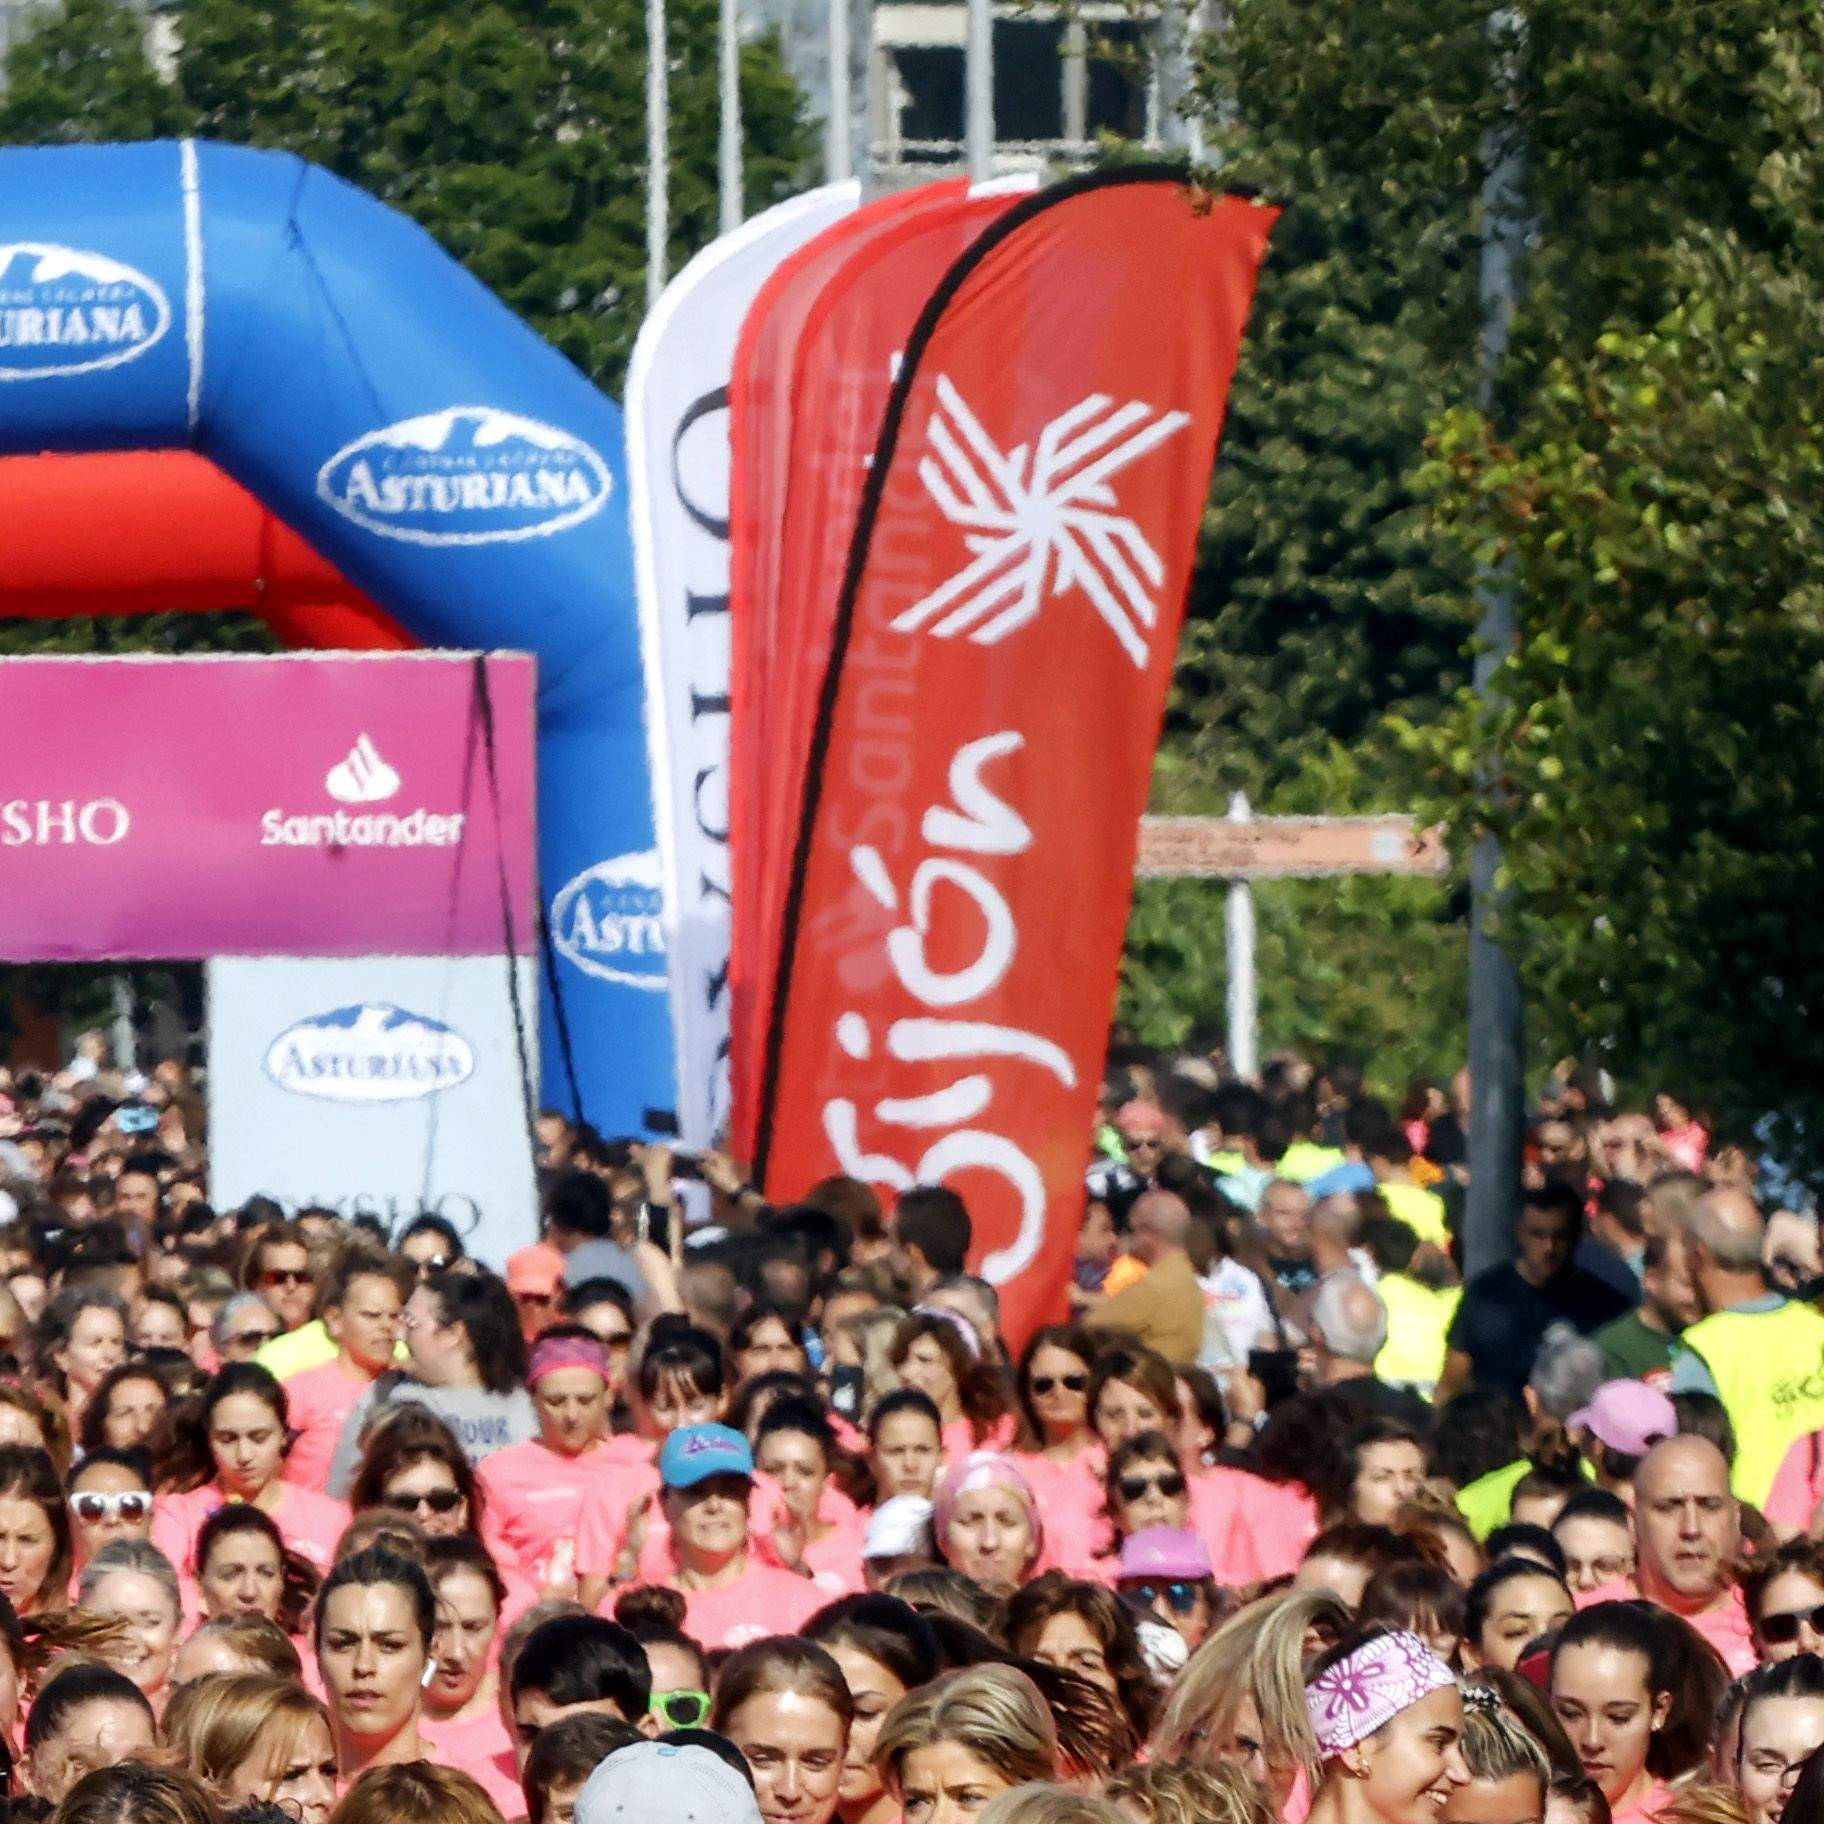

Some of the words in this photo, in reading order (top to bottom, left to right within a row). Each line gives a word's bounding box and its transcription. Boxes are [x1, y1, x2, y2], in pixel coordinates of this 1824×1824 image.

[343, 458, 592, 513] ASTURIANA
[260, 807, 466, 849] Santander
[282, 1041, 465, 1081] ASTURIANA
